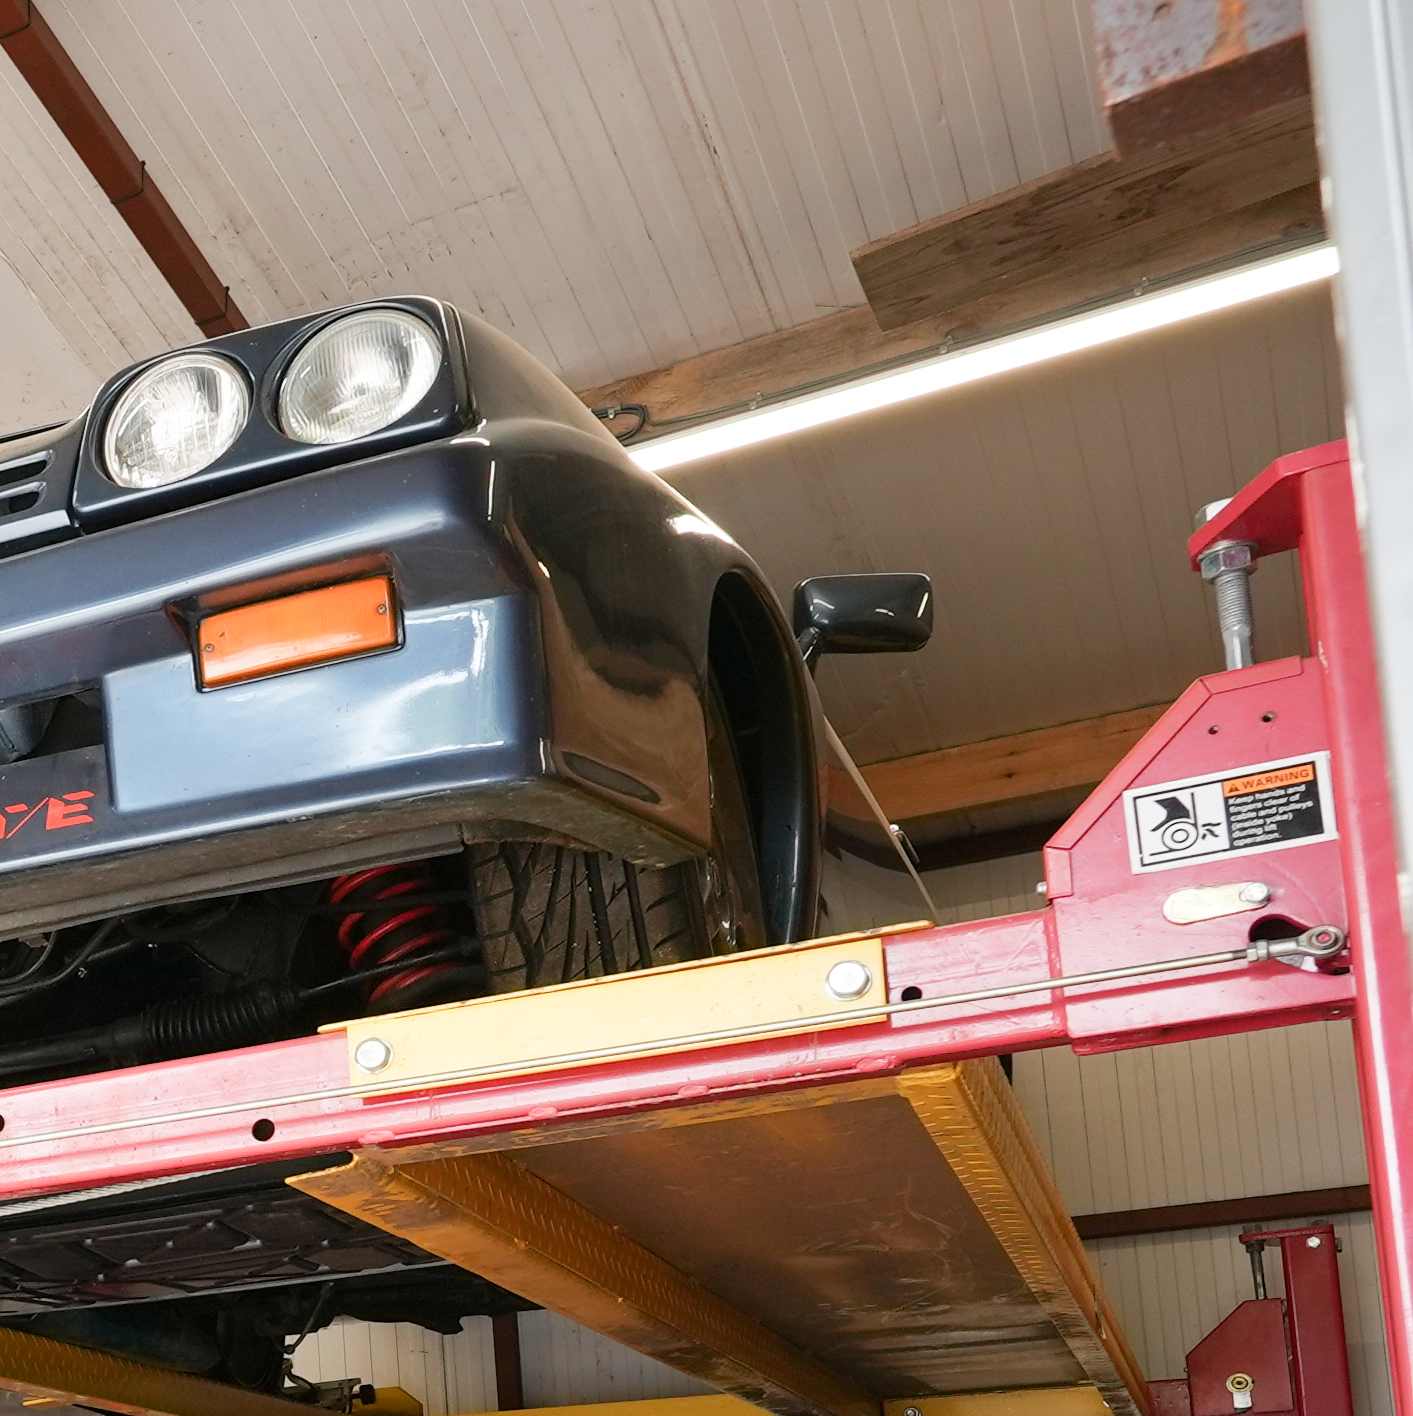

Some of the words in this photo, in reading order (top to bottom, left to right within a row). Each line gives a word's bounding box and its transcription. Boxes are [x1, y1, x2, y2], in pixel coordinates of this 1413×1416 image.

[1241, 769, 1310, 790] WARNING
[1255, 789, 1286, 800] hands
[1286, 784, 1306, 793] and
[1264, 797, 1289, 807] clear
[1258, 807, 1277, 816] and
